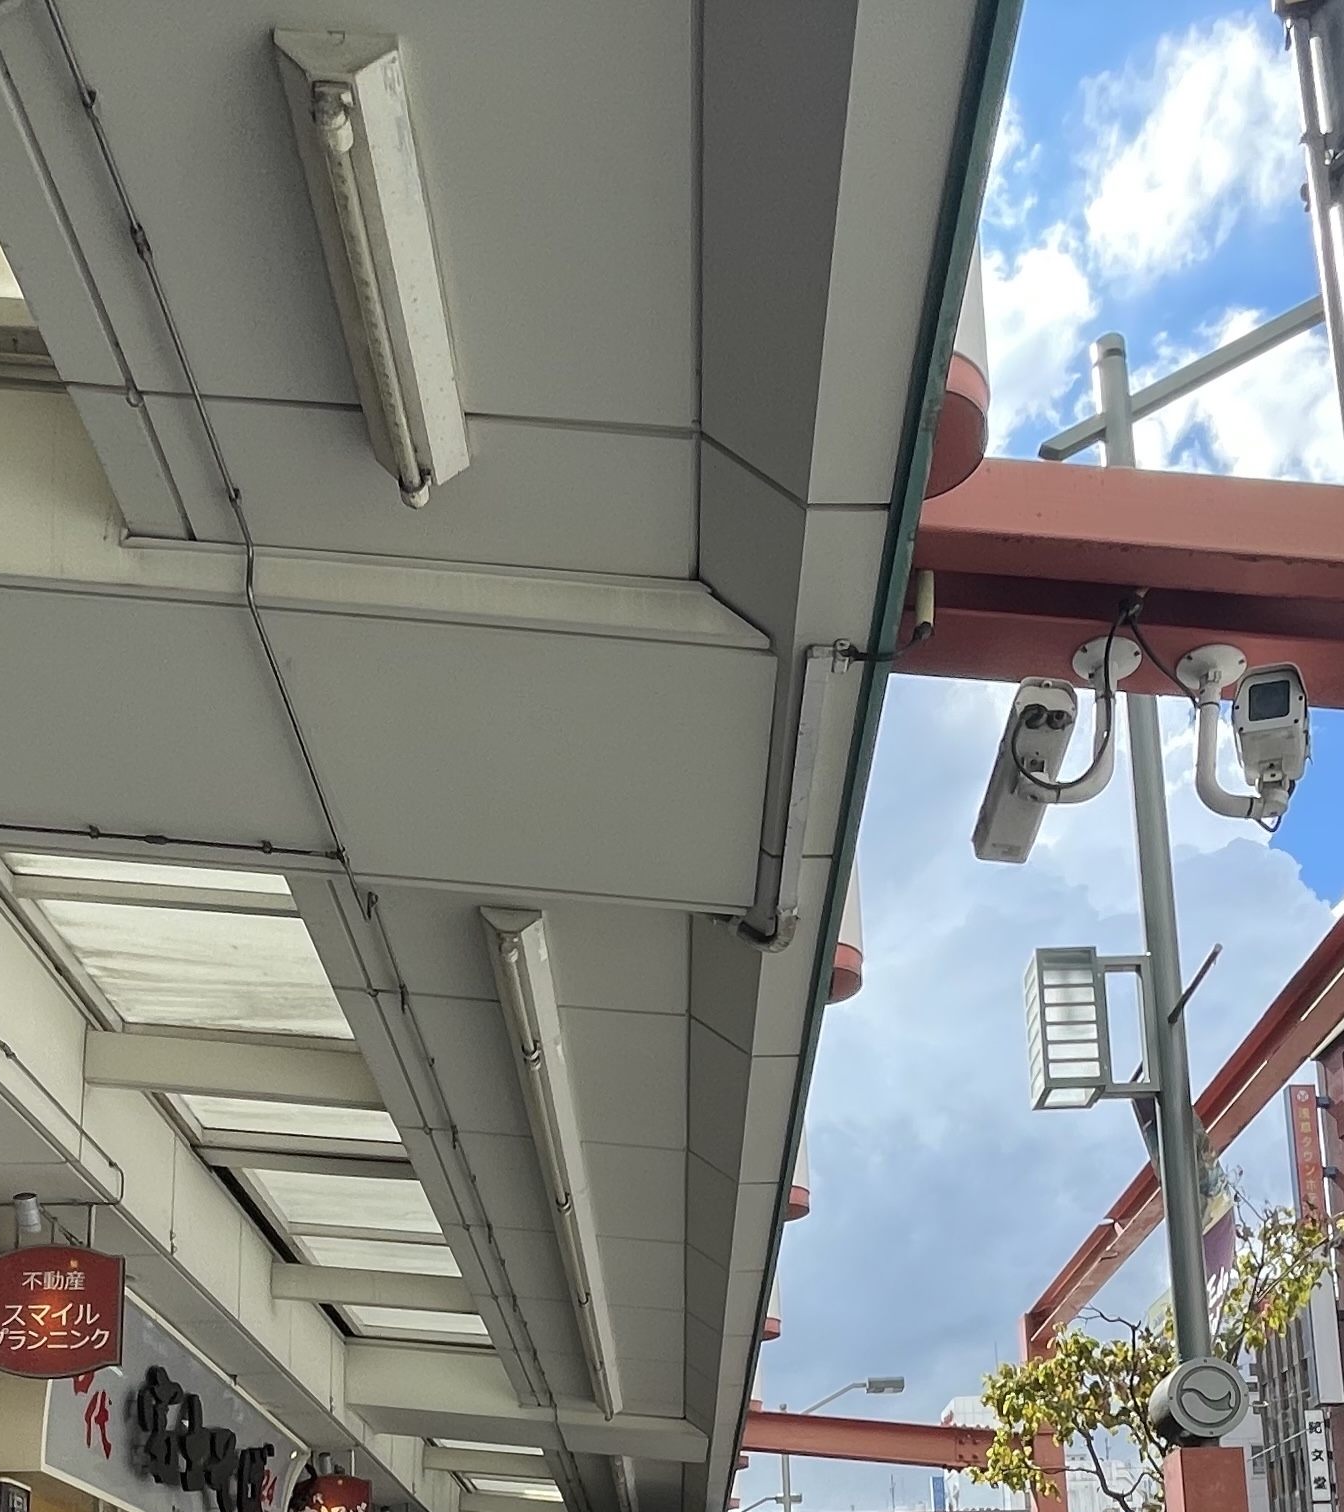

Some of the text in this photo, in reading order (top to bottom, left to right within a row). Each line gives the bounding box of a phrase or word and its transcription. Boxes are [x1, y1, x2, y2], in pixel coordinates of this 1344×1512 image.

[21, 1270, 86, 1291] 不動産
[1, 1302, 100, 1327] スマイル
